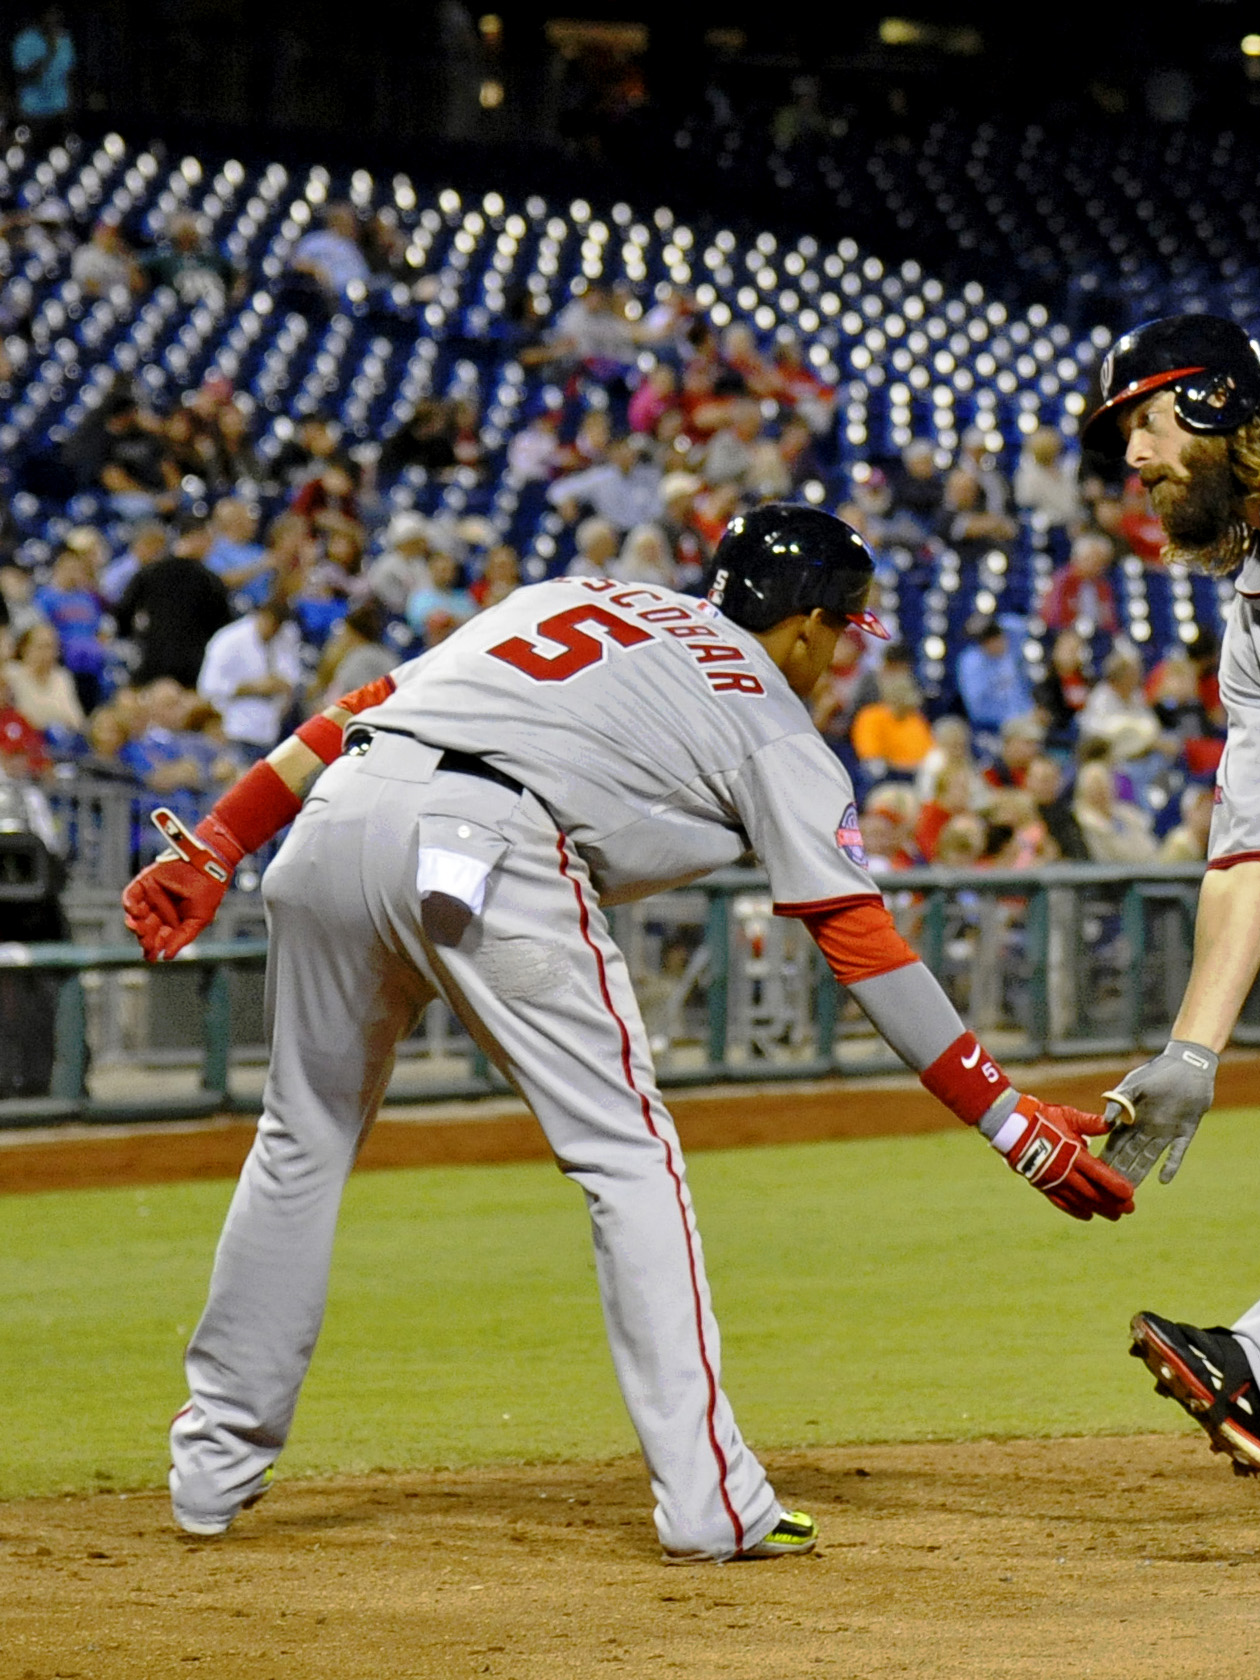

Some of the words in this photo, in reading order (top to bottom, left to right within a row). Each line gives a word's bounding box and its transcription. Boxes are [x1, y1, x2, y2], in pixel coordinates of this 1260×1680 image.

[712, 568, 730, 591] 5
[484, 603, 659, 683] 5
[549, 576, 766, 696] SCOBAR
[981, 1061, 999, 1083] 5
